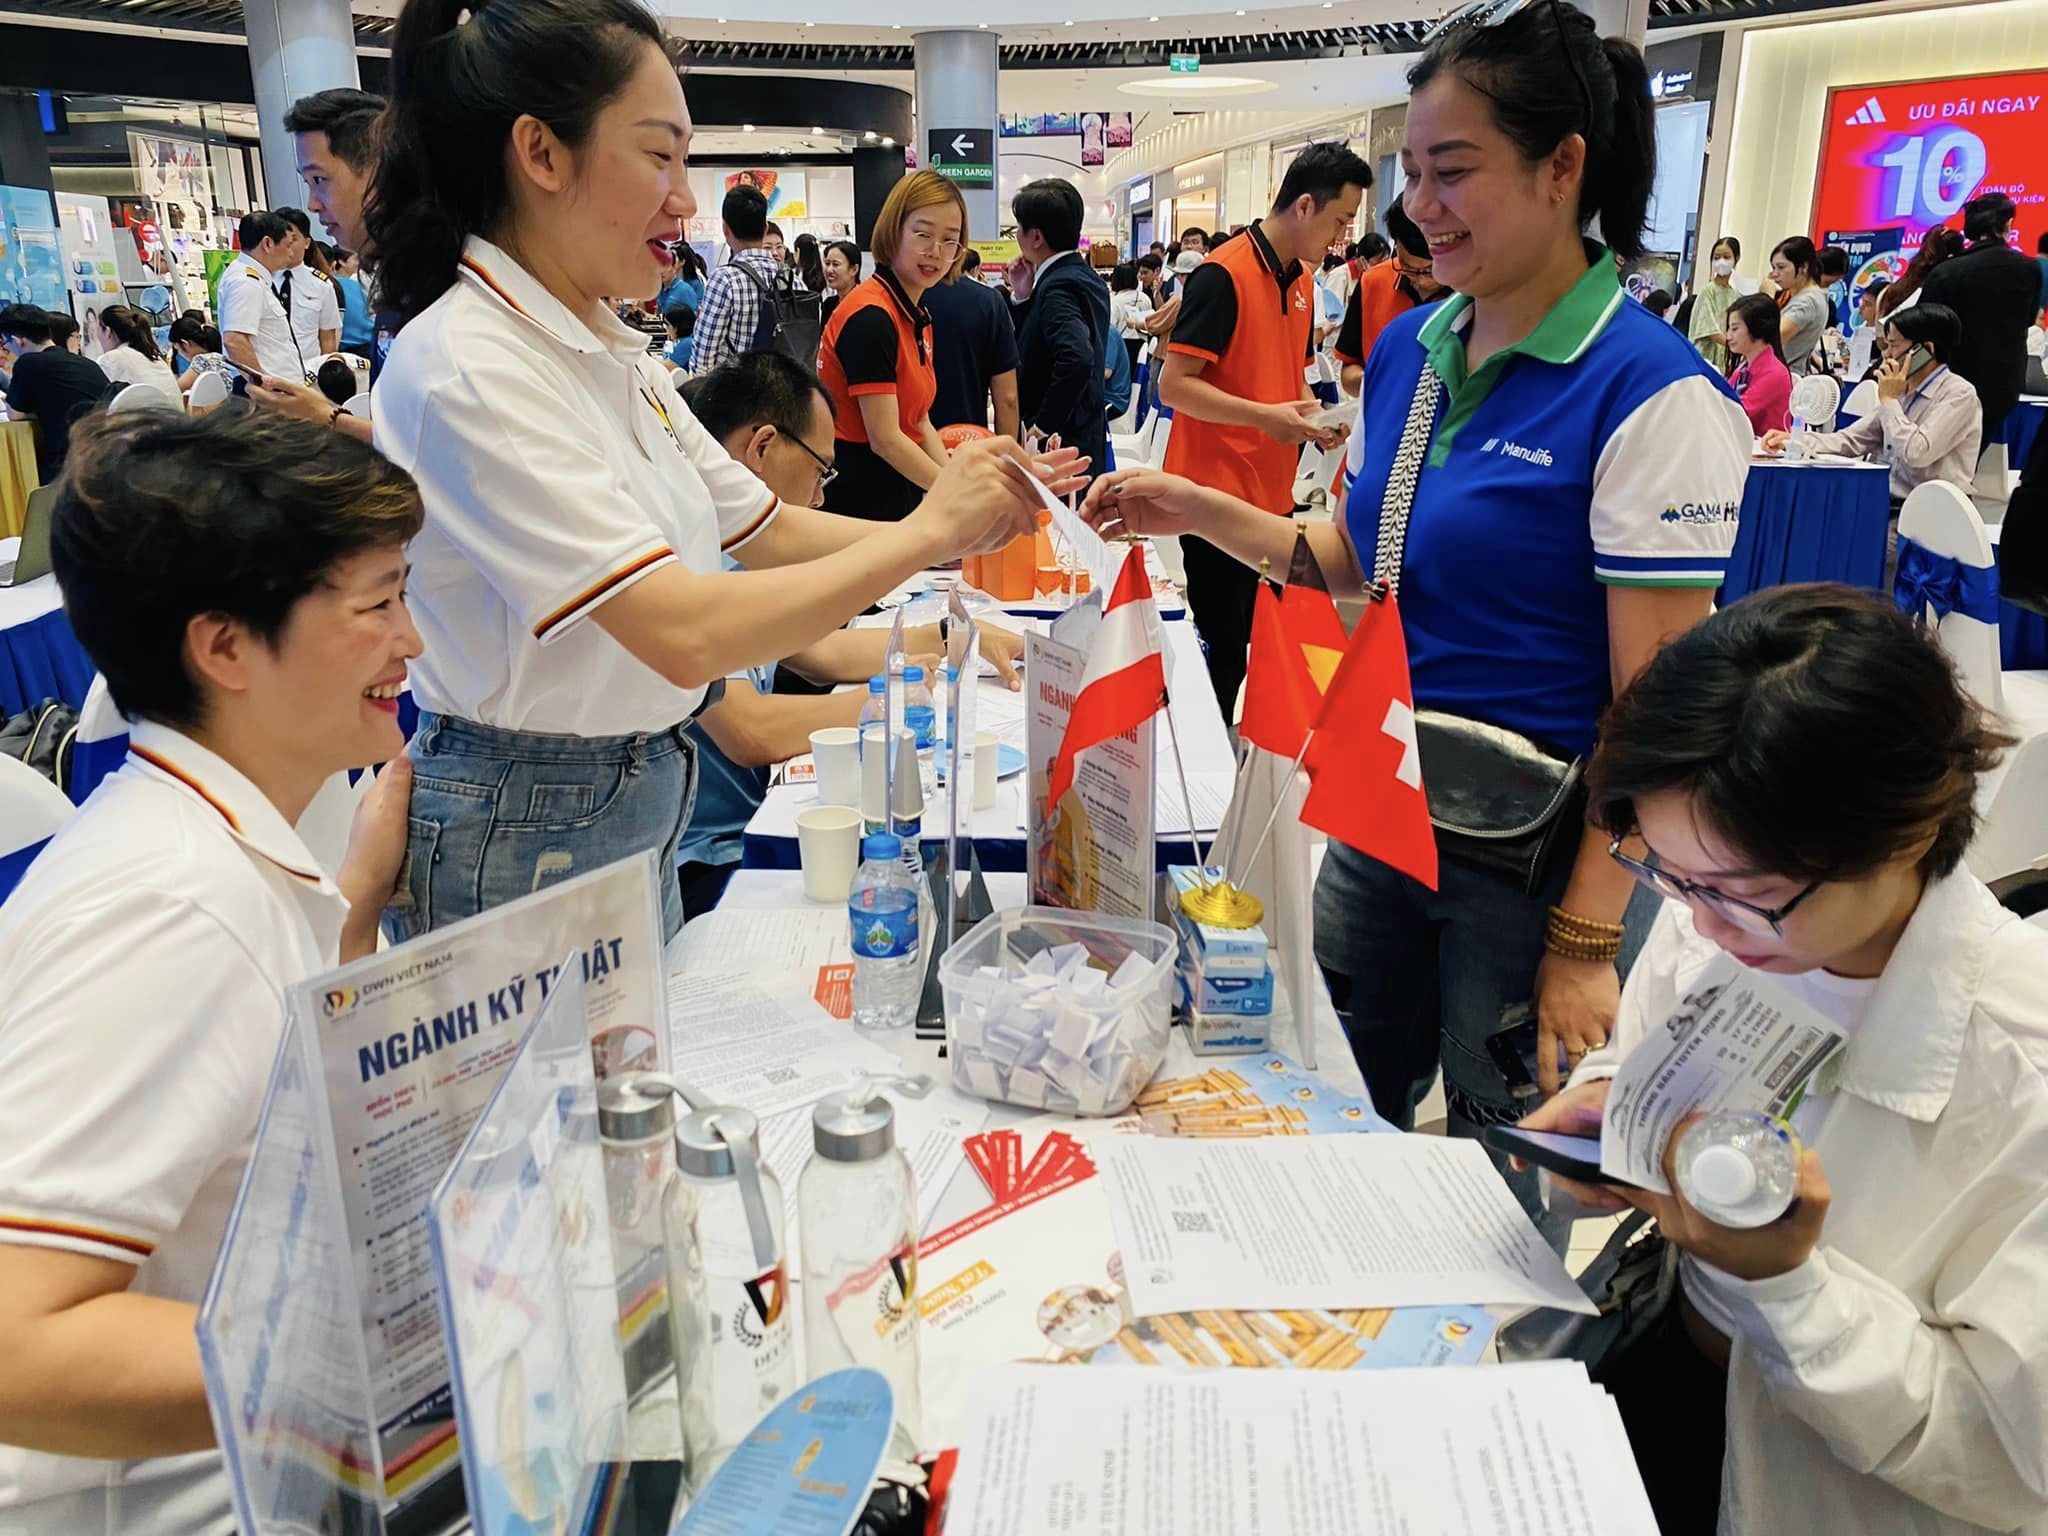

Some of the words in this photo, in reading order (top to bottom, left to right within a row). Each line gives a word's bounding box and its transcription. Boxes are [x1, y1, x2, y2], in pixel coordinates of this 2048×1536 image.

[1908, 102, 1936, 120] ƯU
[1941, 98, 1976, 117] ĐÃI
[1981, 96, 2040, 115] NGAY
[1501, 441, 1553, 467] Manulife
[1681, 503, 1721, 518] GAMA
[362, 974, 395, 996] DWN
[357, 1001, 479, 1083] NGÀNH
[487, 973, 527, 1026] KỸ
